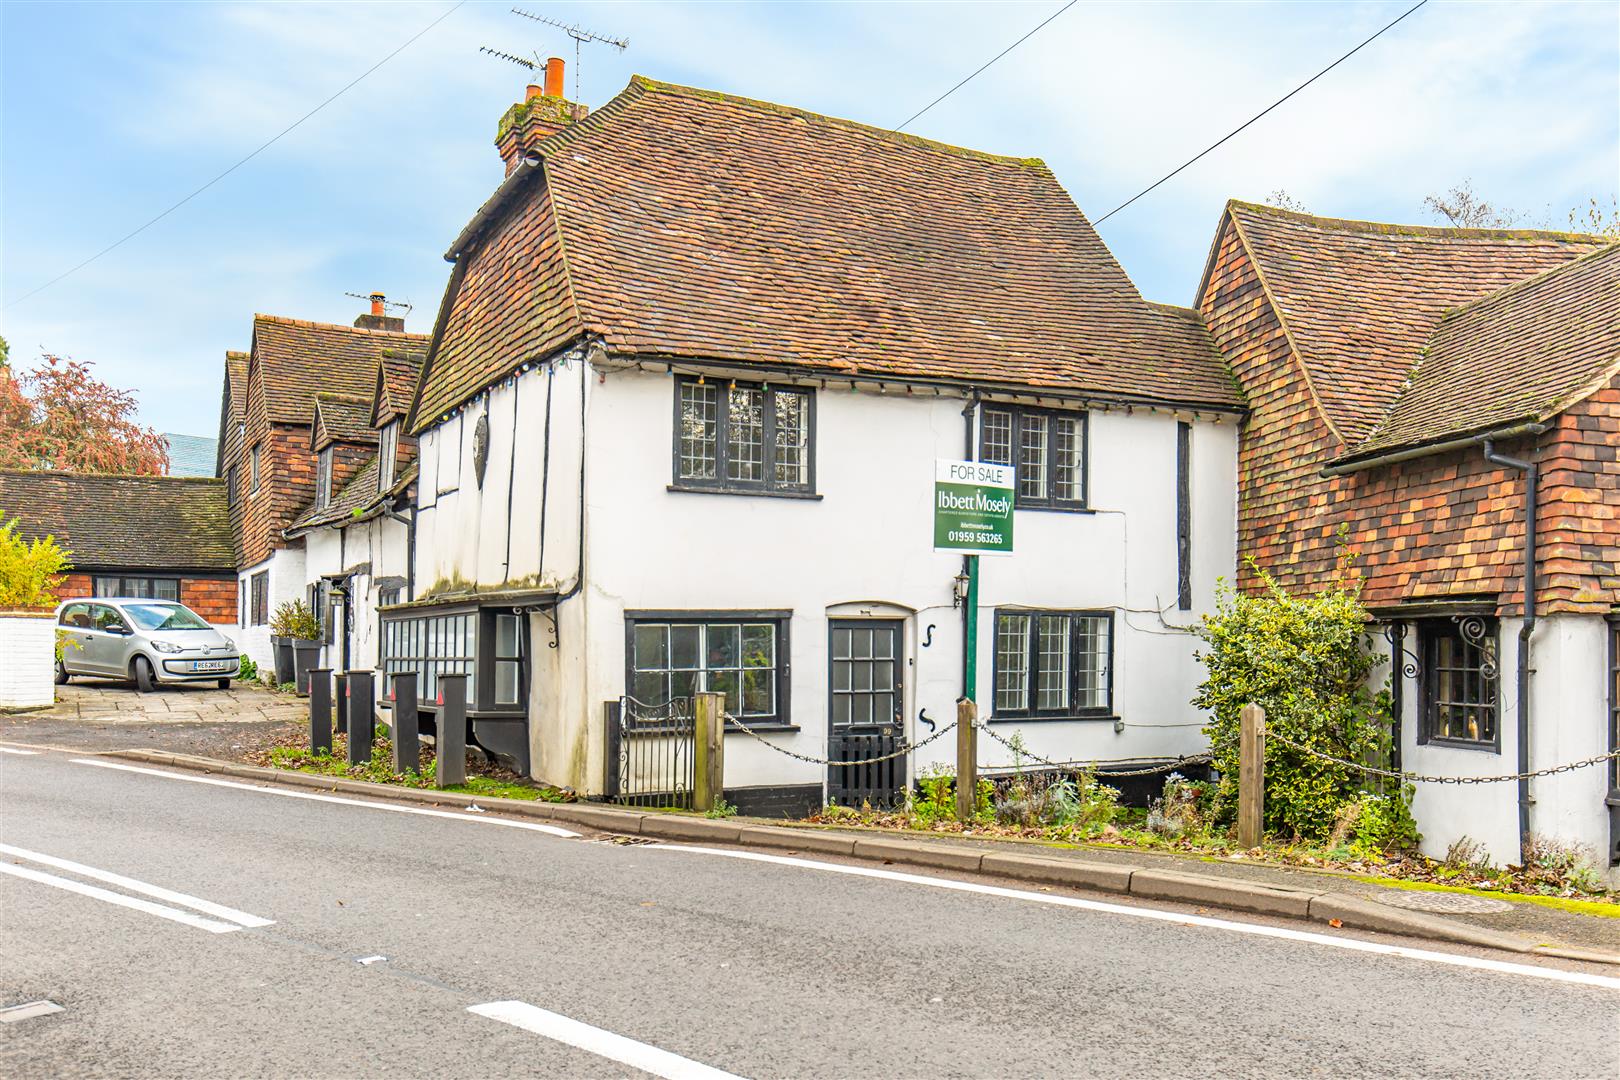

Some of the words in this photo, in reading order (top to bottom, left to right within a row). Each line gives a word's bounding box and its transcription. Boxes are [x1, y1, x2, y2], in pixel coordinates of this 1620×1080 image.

[951, 465, 975, 480] FOR
[978, 467, 1003, 484] SALE
[938, 490, 975, 510] Ibbett
[975, 489, 1011, 519] Mosely
[948, 531, 974, 542] 01959
[976, 532, 1003, 544] 563265
